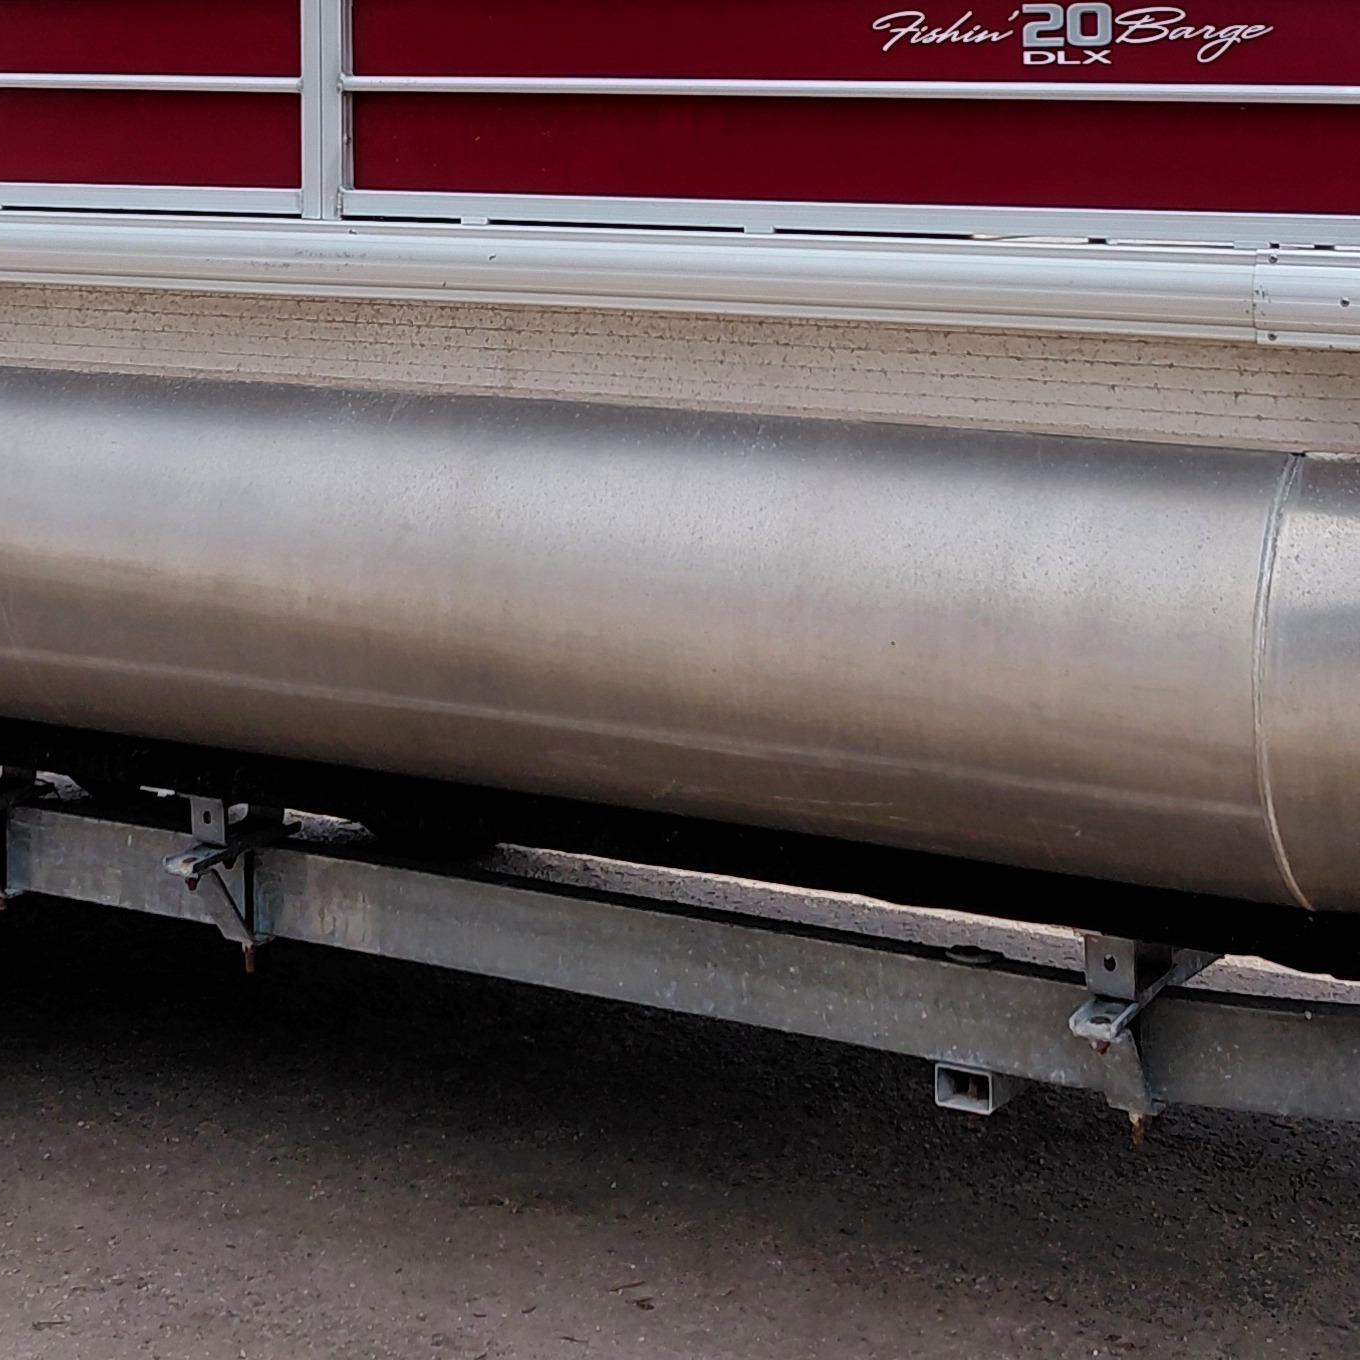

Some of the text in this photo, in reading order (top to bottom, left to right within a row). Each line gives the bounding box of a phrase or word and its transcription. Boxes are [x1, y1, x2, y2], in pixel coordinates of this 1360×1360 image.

[1022, 2, 1112, 48] 20
[1114, 6, 1274, 63] Barge
[1022, 50, 1112, 65] DLX
